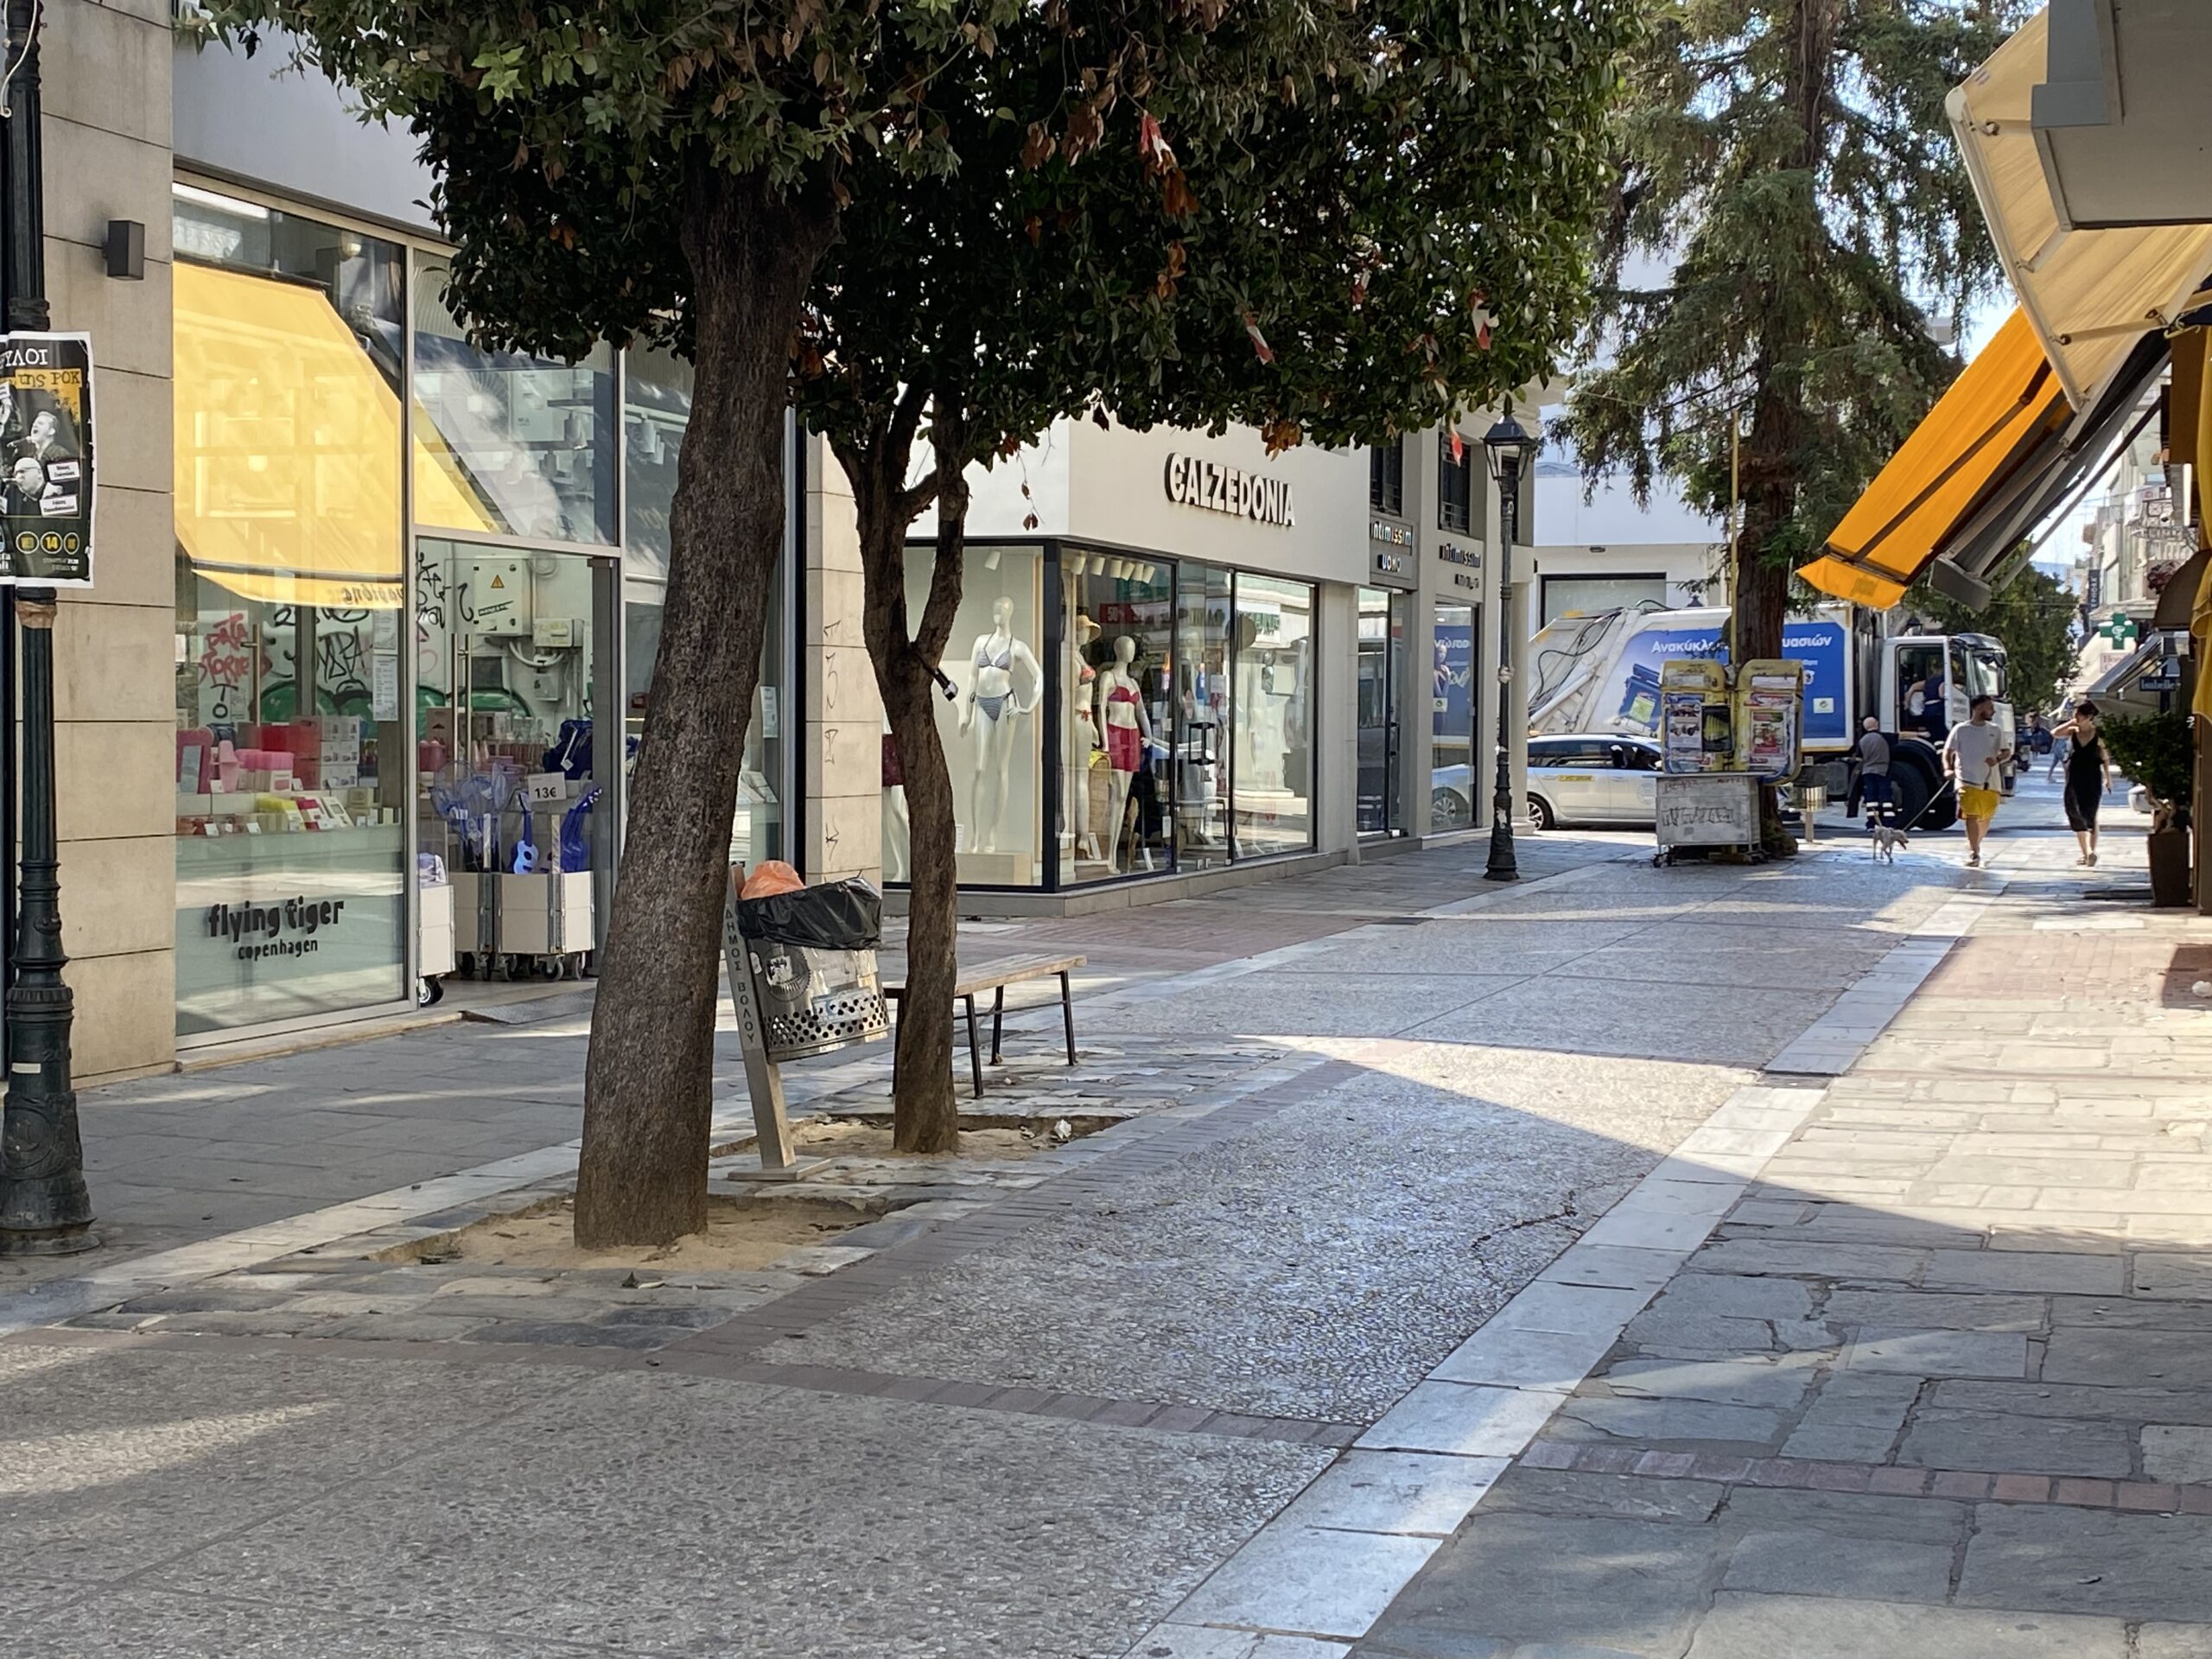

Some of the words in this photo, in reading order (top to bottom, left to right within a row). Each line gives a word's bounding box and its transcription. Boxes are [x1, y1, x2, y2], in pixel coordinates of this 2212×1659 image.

[1165, 451, 1296, 527] CALZEDONIA
[1782, 632, 1833, 648] υασιών
[535, 786, 556, 799] 13€
[209, 900, 281, 943] flying
[285, 895, 345, 934] tiger
[238, 938, 318, 961] copenhagen
[725, 908, 743, 971] ΔΗΜΟΣ
[737, 982, 755, 1044] ΒΟΛΟΥ
